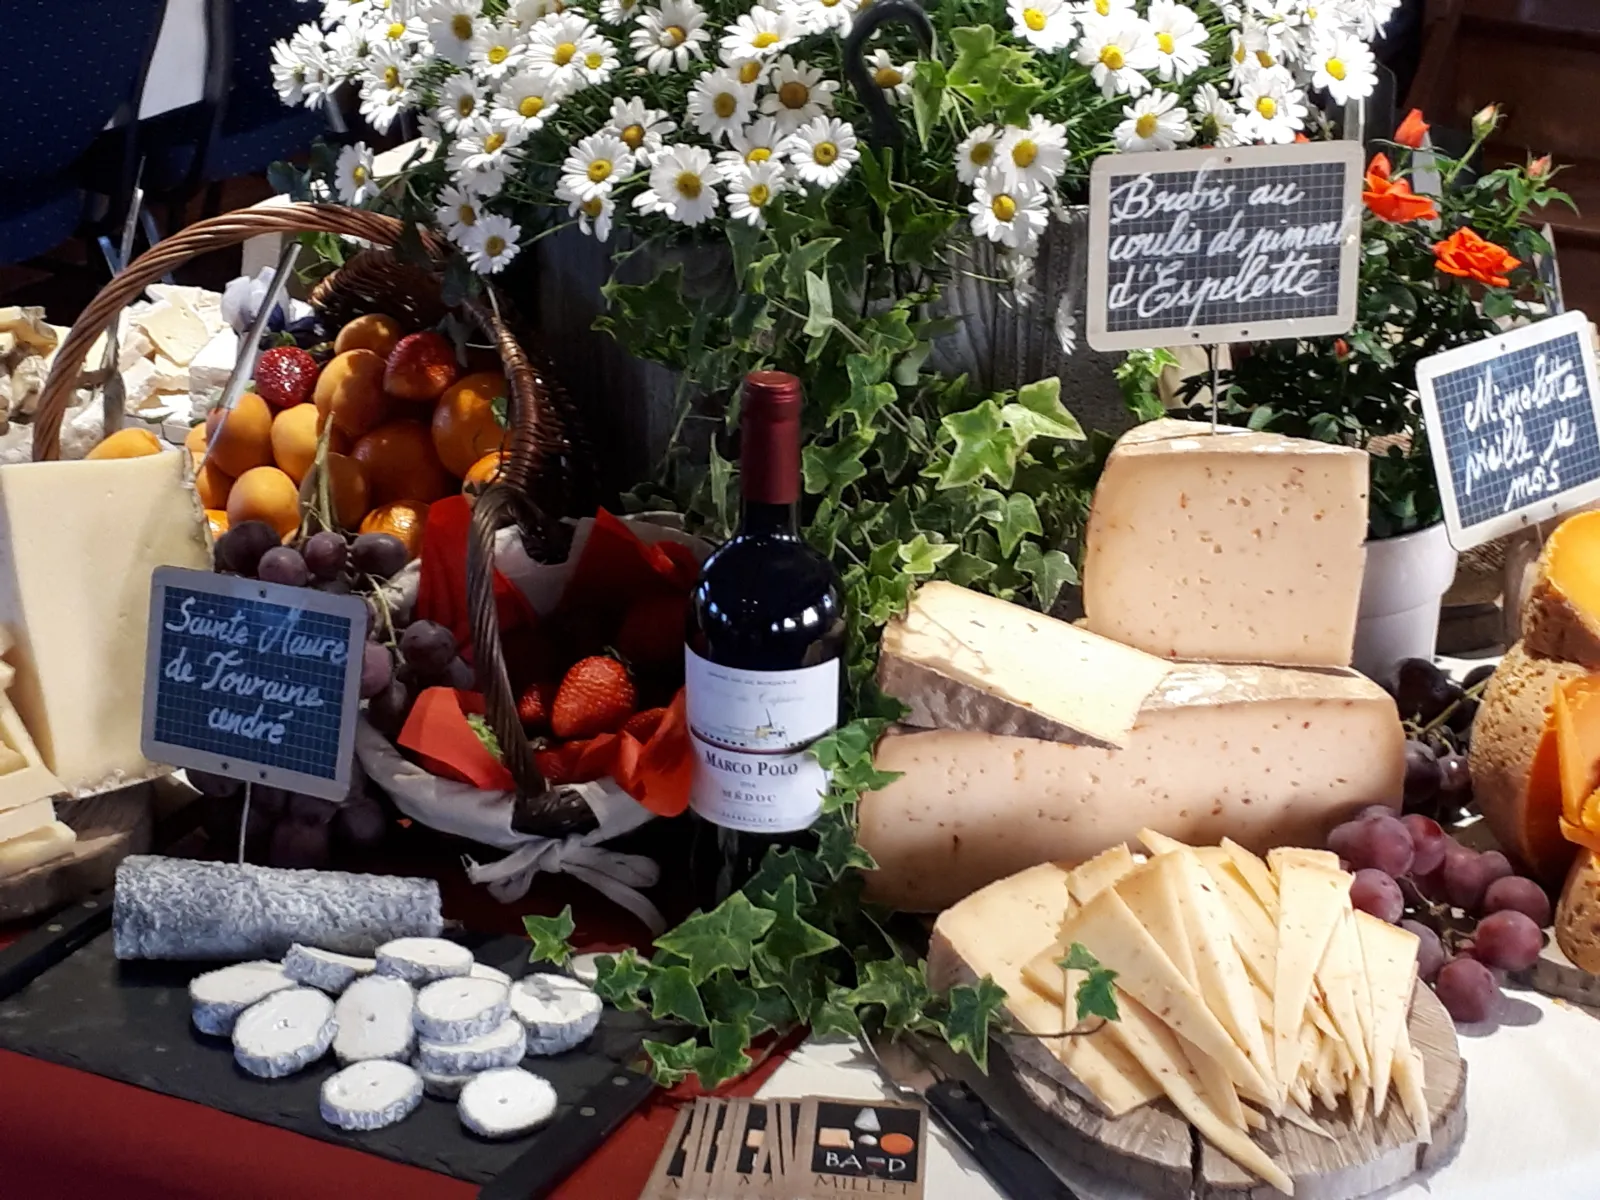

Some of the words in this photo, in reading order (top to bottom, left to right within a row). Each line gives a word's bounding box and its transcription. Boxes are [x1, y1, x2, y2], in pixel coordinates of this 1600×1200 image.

[1110, 158, 1236, 225] Brebis
[1249, 182, 1305, 206] au
[1109, 211, 1201, 260] coulis
[1206, 211, 1245, 257] de
[1238, 205, 1361, 258] piment
[1108, 252, 1327, 331] d'Espelette
[1464, 354, 1583, 432] Mimolette
[165, 596, 249, 645] Sainte
[258, 605, 349, 664] Maure
[165, 647, 196, 682] de
[201, 650, 324, 707] Touraine
[208, 704, 294, 744] cendré
[704, 751, 752, 775] MARCO
[757, 761, 799, 777] POLO
[722, 788, 777, 802] MÉDOC
